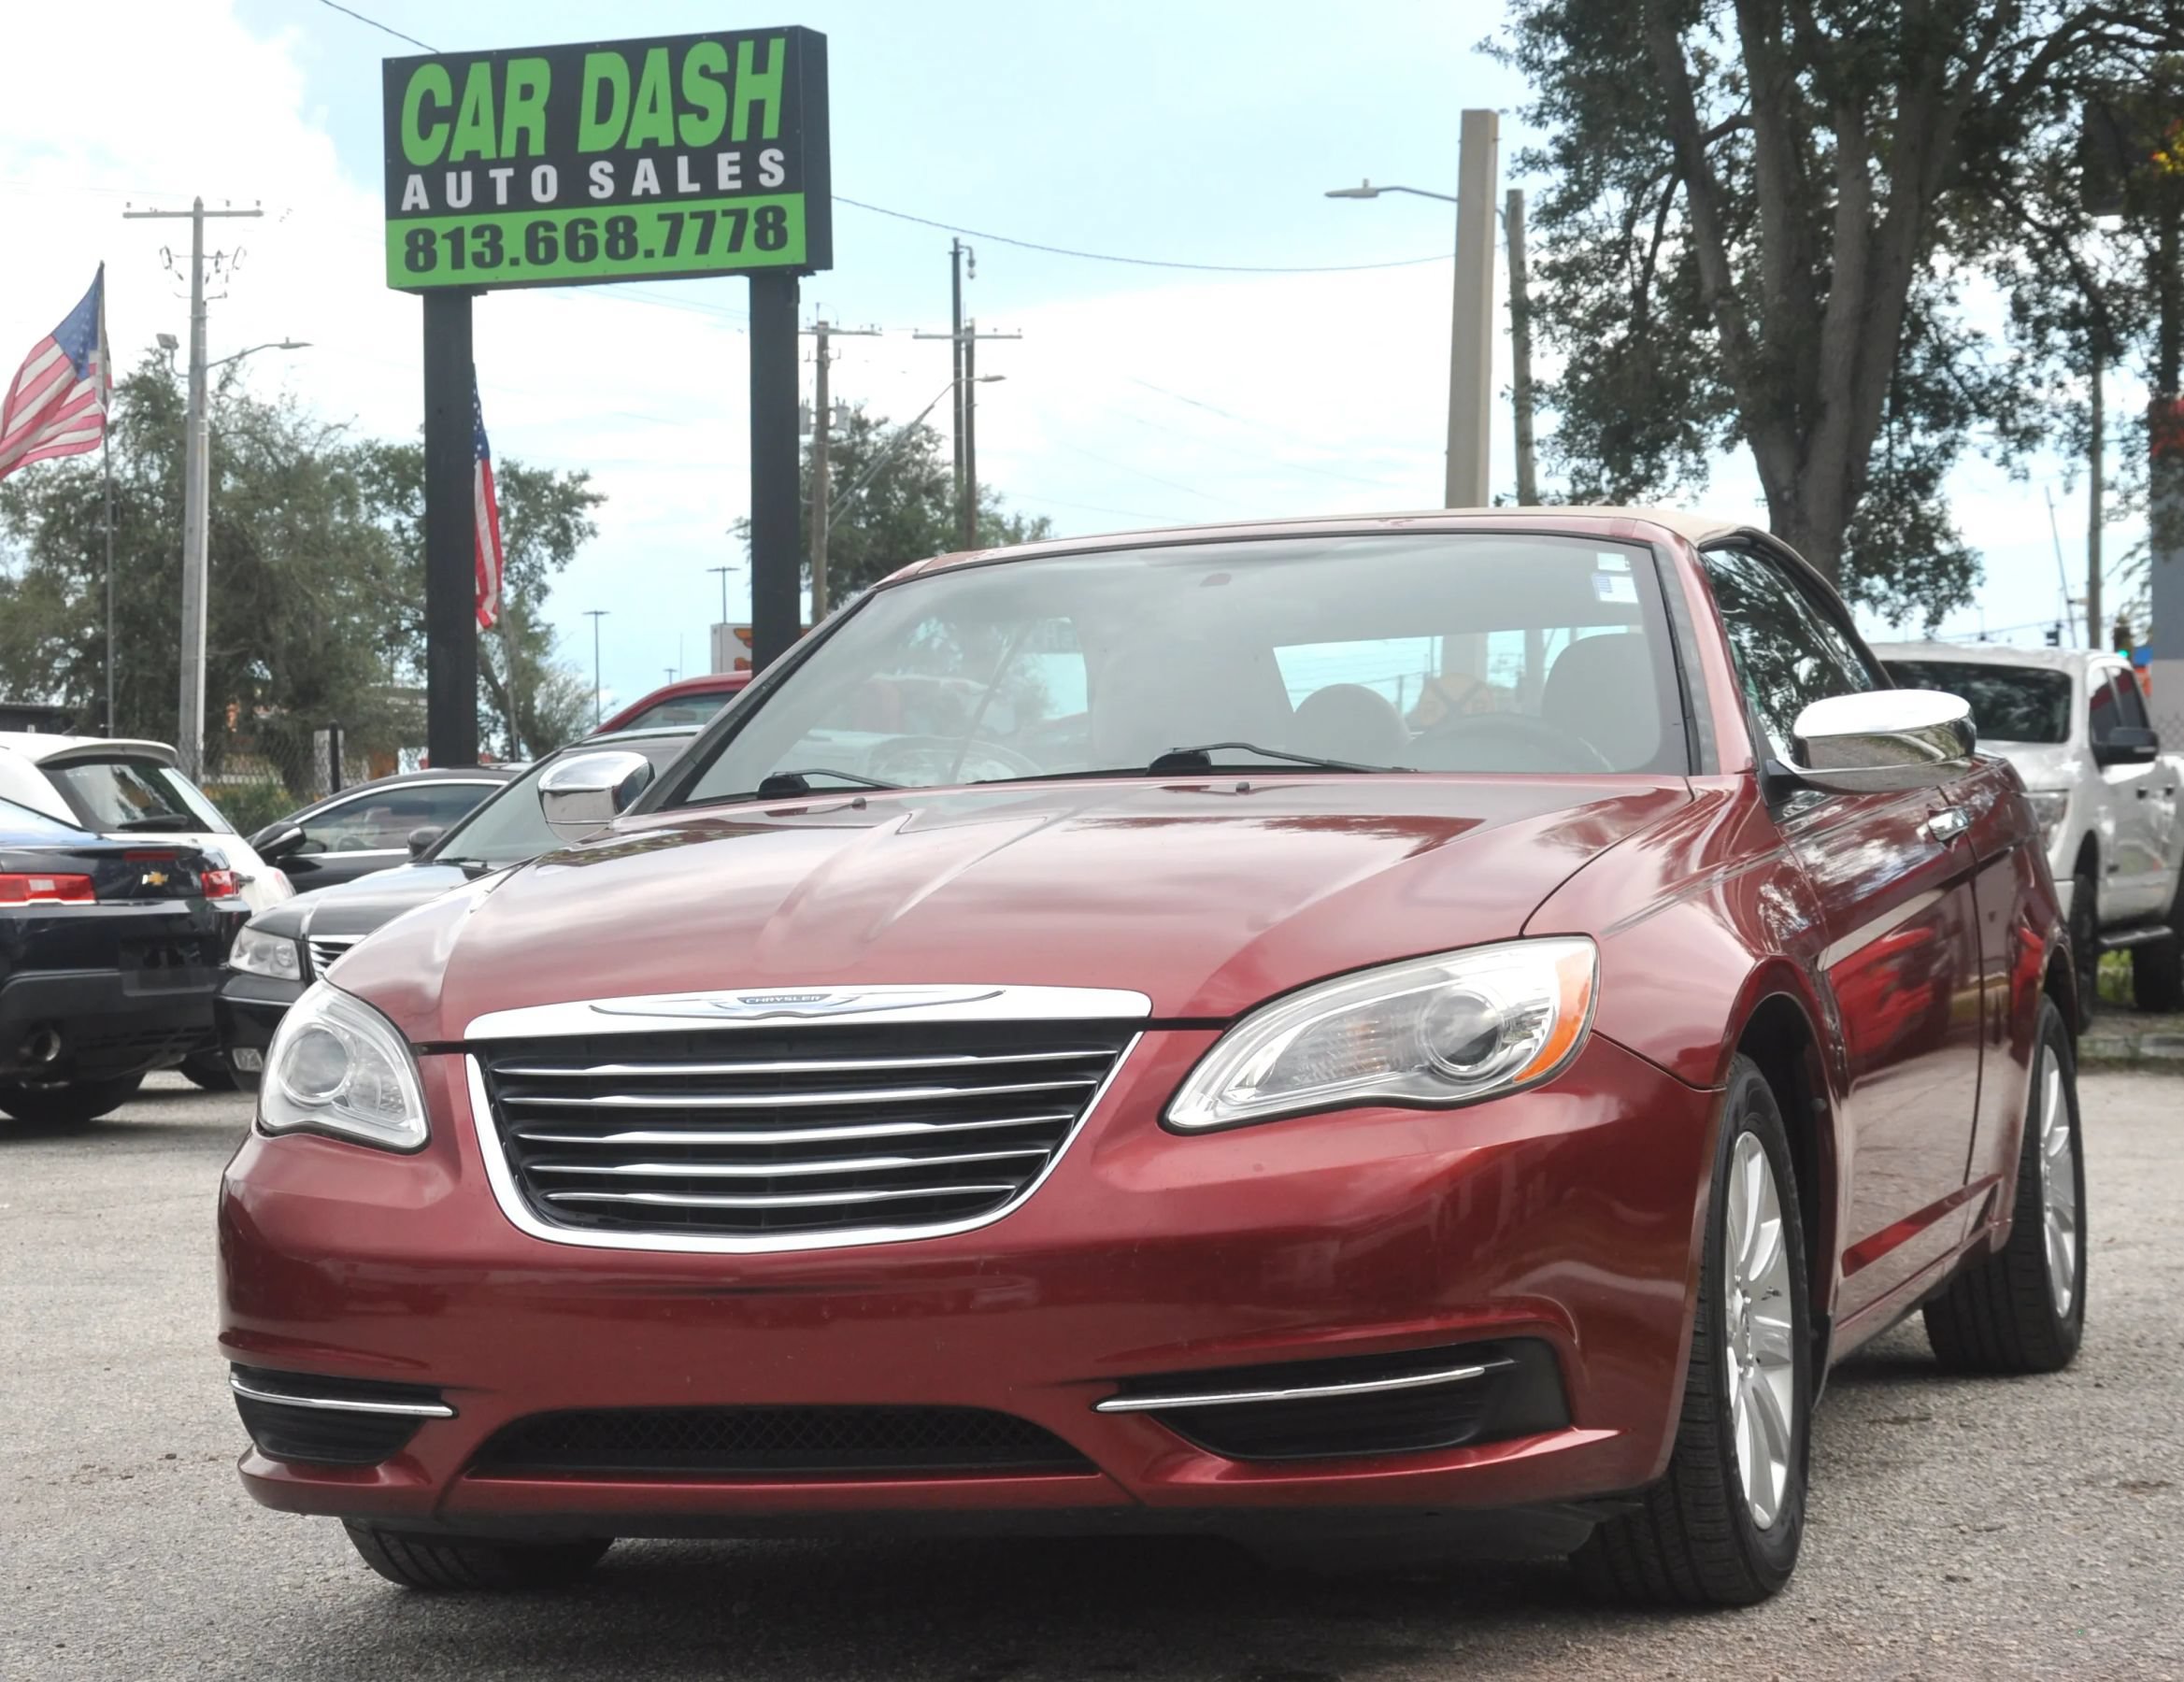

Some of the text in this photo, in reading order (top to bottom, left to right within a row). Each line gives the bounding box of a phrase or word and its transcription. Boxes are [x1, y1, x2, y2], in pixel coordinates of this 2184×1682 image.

[401, 37, 786, 166] CAR DASH
[401, 149, 786, 211] AUTO SALES
[404, 205, 789, 273] 813.668.7778
[746, 994, 821, 1004] CHRYSLER
